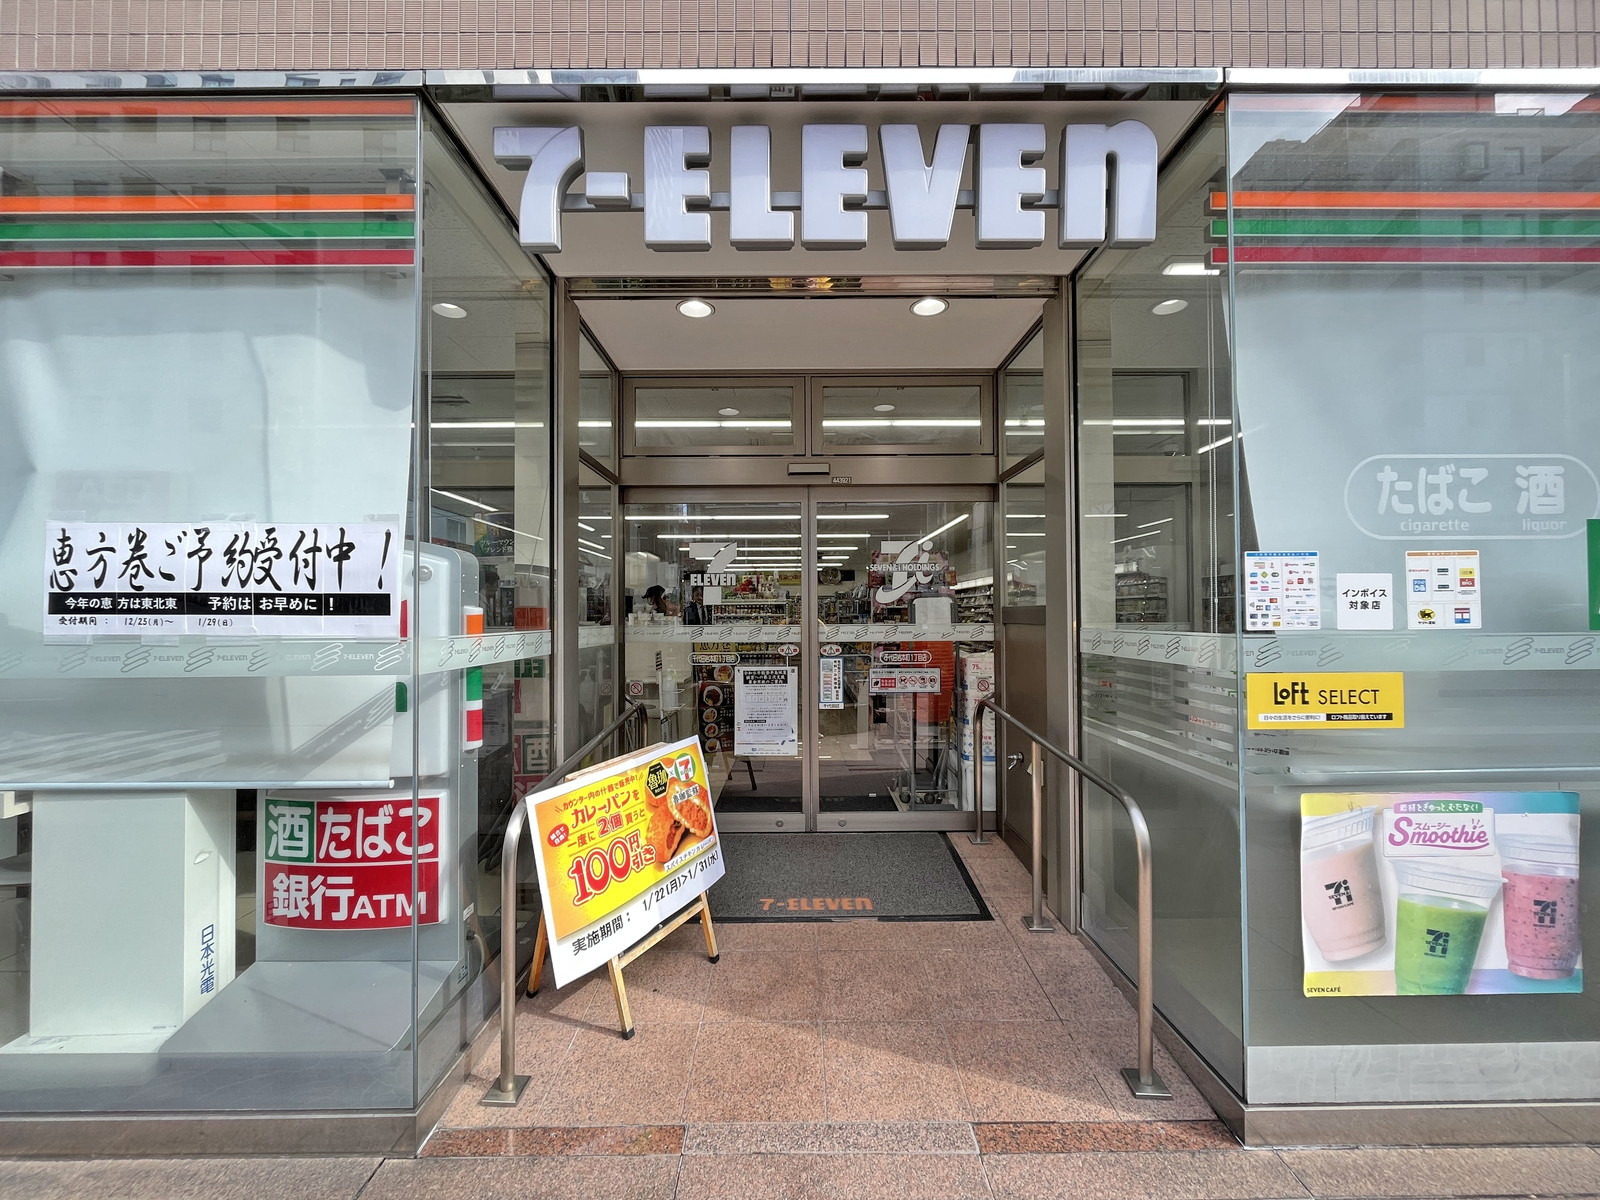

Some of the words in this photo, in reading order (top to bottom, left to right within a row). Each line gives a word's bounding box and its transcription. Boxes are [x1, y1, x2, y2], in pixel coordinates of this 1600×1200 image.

[493, 122, 1159, 252] 7-ELEVEN
[1376, 463, 1492, 516] たばこ
[1515, 464, 1565, 515] 酒
[1400, 518, 1470, 534] cigarette
[1522, 518, 1567, 532] liquor
[902, 563, 940, 571] HOLDINGS
[690, 573, 736, 586] ELEVEN
[1342, 588, 1388, 598] インボイス
[1348, 600, 1381, 610] 対象店
[1534, 647, 1565, 655] 7-ELEVEN
[1318, 689, 1380, 705] SELECT
[268, 803, 312, 858] 酒
[319, 803, 434, 861] たばこ
[1388, 816, 1489, 847] Smoothie
[1413, 822, 1451, 830] スムージー
[759, 897, 874, 911] 7-ELEVEN
